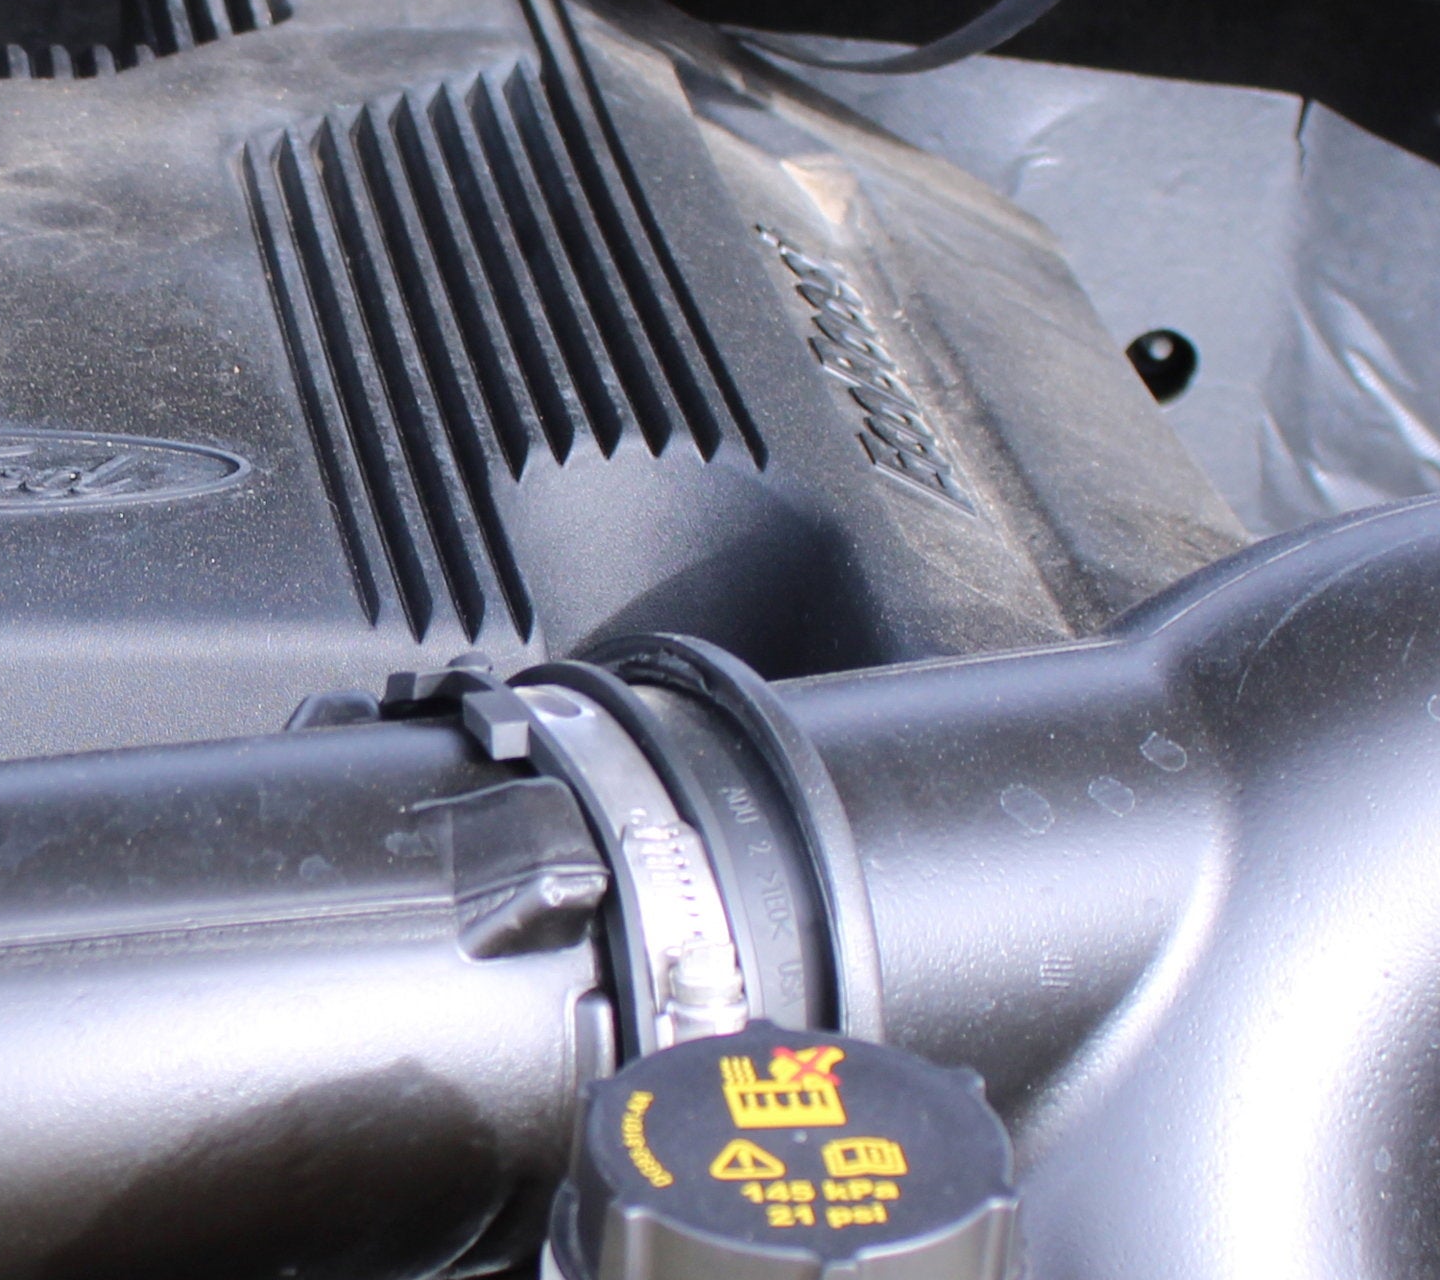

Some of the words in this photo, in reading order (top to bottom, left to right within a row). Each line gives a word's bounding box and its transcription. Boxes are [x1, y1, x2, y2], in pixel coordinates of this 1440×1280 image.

[740, 1178, 817, 1204] 145
[821, 1177, 901, 1203] kPa
[765, 1202, 816, 1228] 21
[825, 1199, 889, 1230] psi
